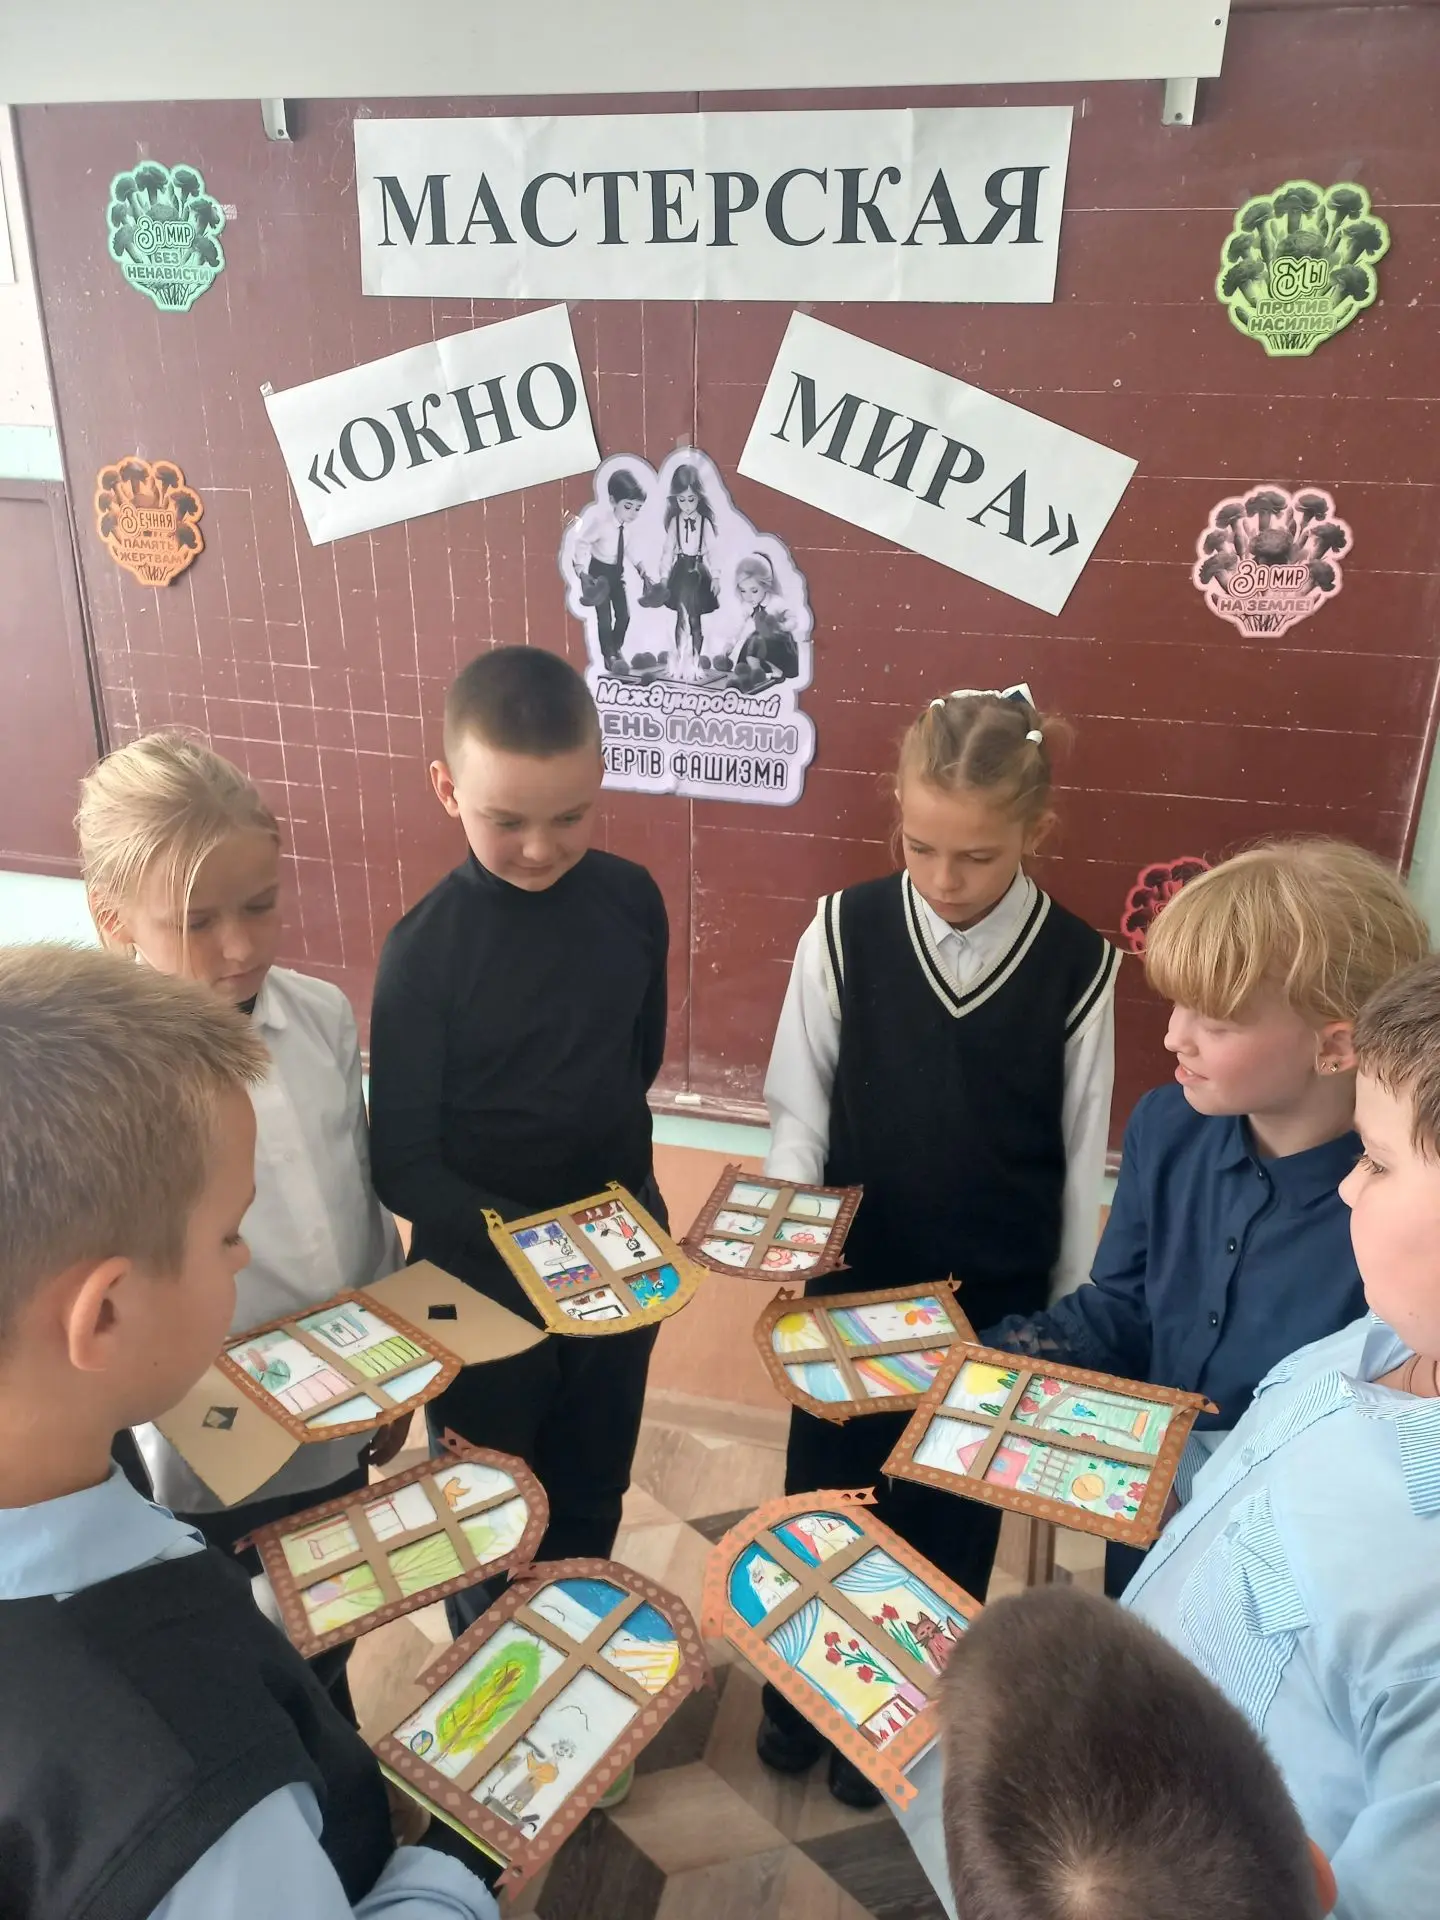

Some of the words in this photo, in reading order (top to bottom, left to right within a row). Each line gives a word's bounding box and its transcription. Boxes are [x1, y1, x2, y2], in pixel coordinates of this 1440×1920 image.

[374, 166, 1050, 247] МАСТЕРСКАЯ
[154, 252, 180, 265] БЕЗ
[127, 266, 210, 281] НЕНАВИСТИ
[1258, 301, 1329, 315] ПРОТИВ
[1250, 317, 1334, 331] НАСИЛИЯ
[308, 361, 577, 494] «ОКНО
[770, 371, 1079, 556] МИРА»
[124, 538, 175, 551] ПАМЯТЬ
[120, 552, 183, 564] ЖЕРТВАМ
[1220, 599, 1244, 612] НА
[1247, 599, 1311, 612] ЗЕМЛЕ!
[603, 713, 661, 738] ЕНЬ
[667, 717, 797, 752] ПАМЯТИ
[672, 752, 786, 787] ФАШИЗМА
